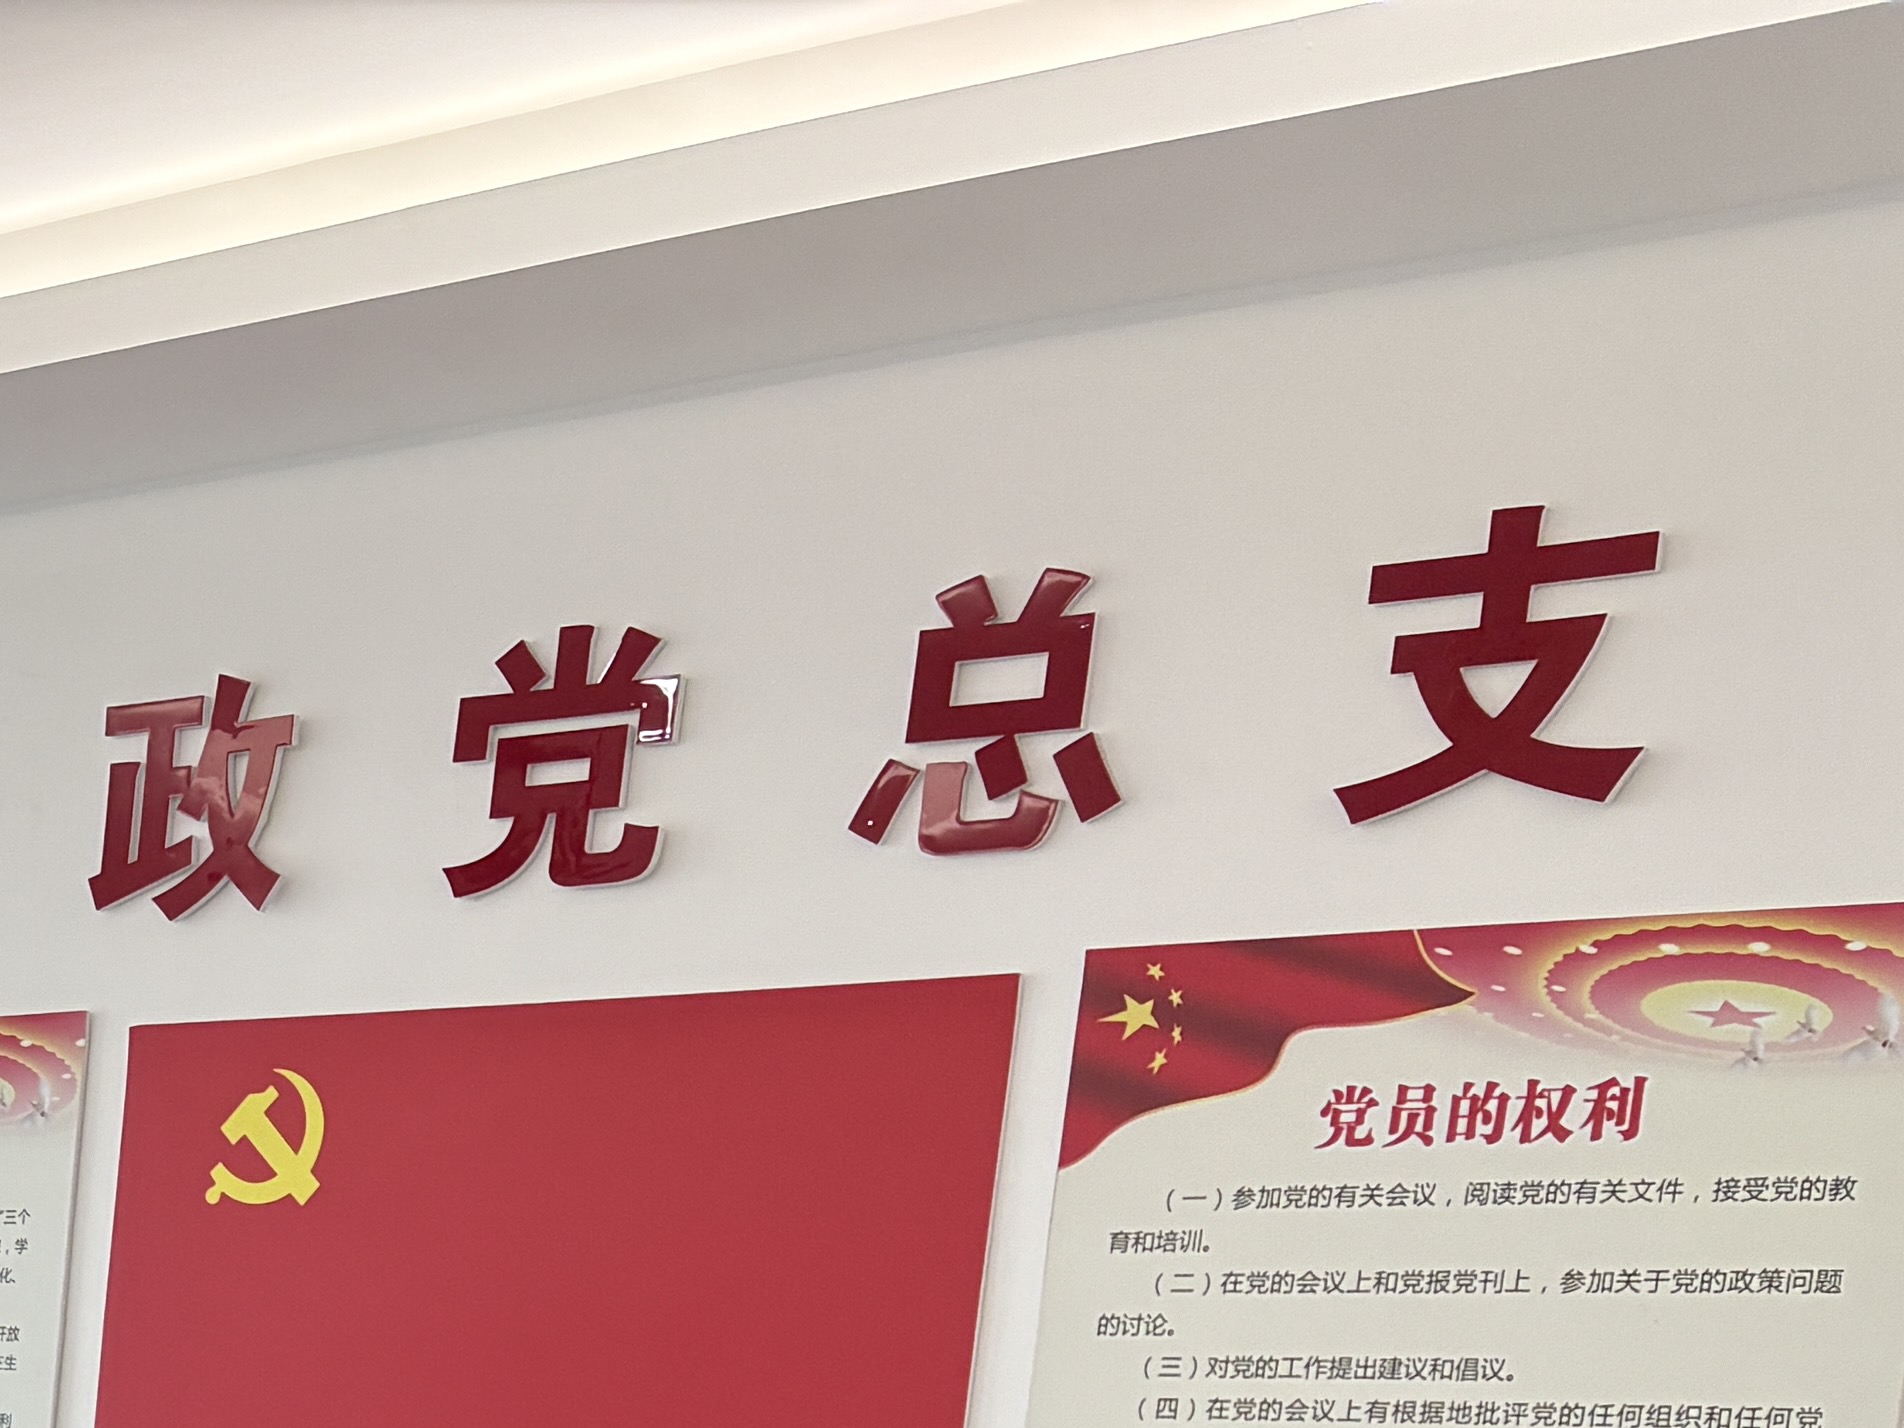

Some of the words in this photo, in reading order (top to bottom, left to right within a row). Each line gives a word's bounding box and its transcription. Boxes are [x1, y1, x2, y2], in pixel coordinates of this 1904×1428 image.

[1314, 1075, 1650, 1152] 党员的权利
[1163, 1175, 1859, 1215] （一）参加党的有关会议，阅读党的有关文件，接受党的教
[1108, 1228, 1213, 1256] 育和培训。
[1152, 1267, 1845, 1299] （二）在党的会议上和党报党刊上，参加关于党的政策问题
[1096, 1311, 1177, 1339] 的讨论。
[1141, 1354, 1519, 1384] （三）对党的工作提出建议和倡议。
